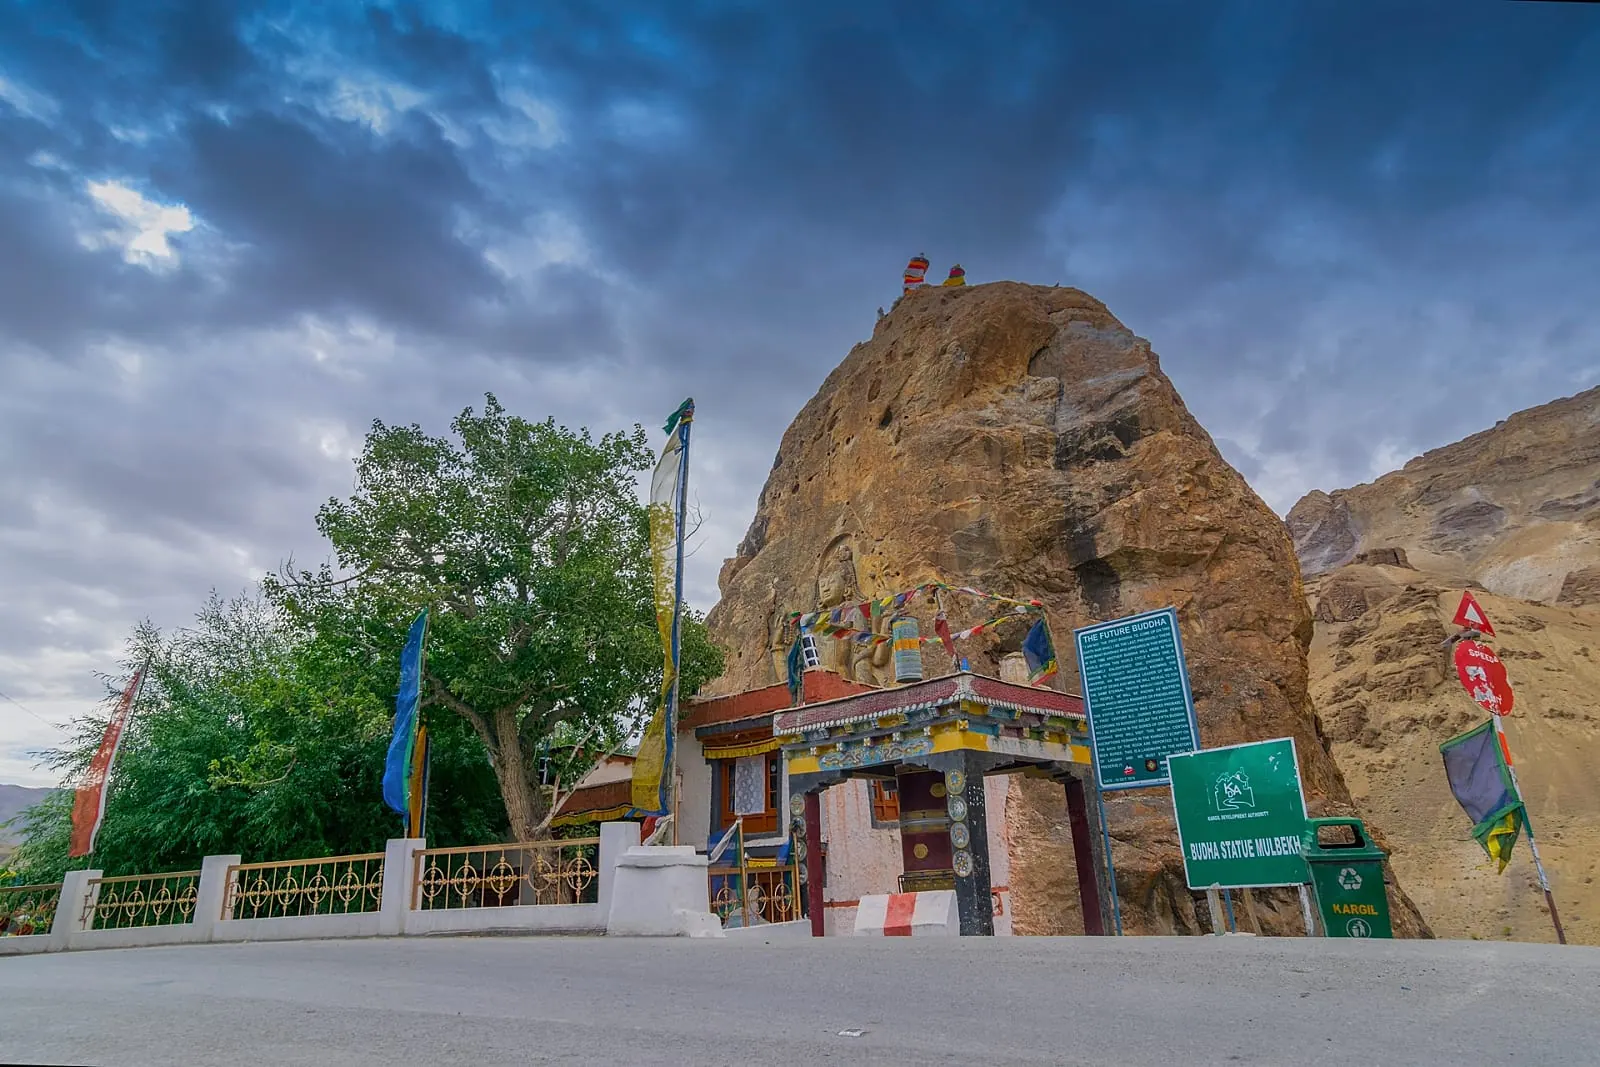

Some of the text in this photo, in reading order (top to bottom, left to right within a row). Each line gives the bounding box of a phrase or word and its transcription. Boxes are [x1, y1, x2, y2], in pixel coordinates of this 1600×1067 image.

[1084, 634, 1098, 643] THE
[1100, 626, 1130, 640] FUTURE
[1132, 618, 1167, 632] BUDDHA
[1190, 842, 1220, 860] BUDHA
[1220, 840, 1255, 859] STATUE
[1333, 904, 1378, 915] KARGIL
